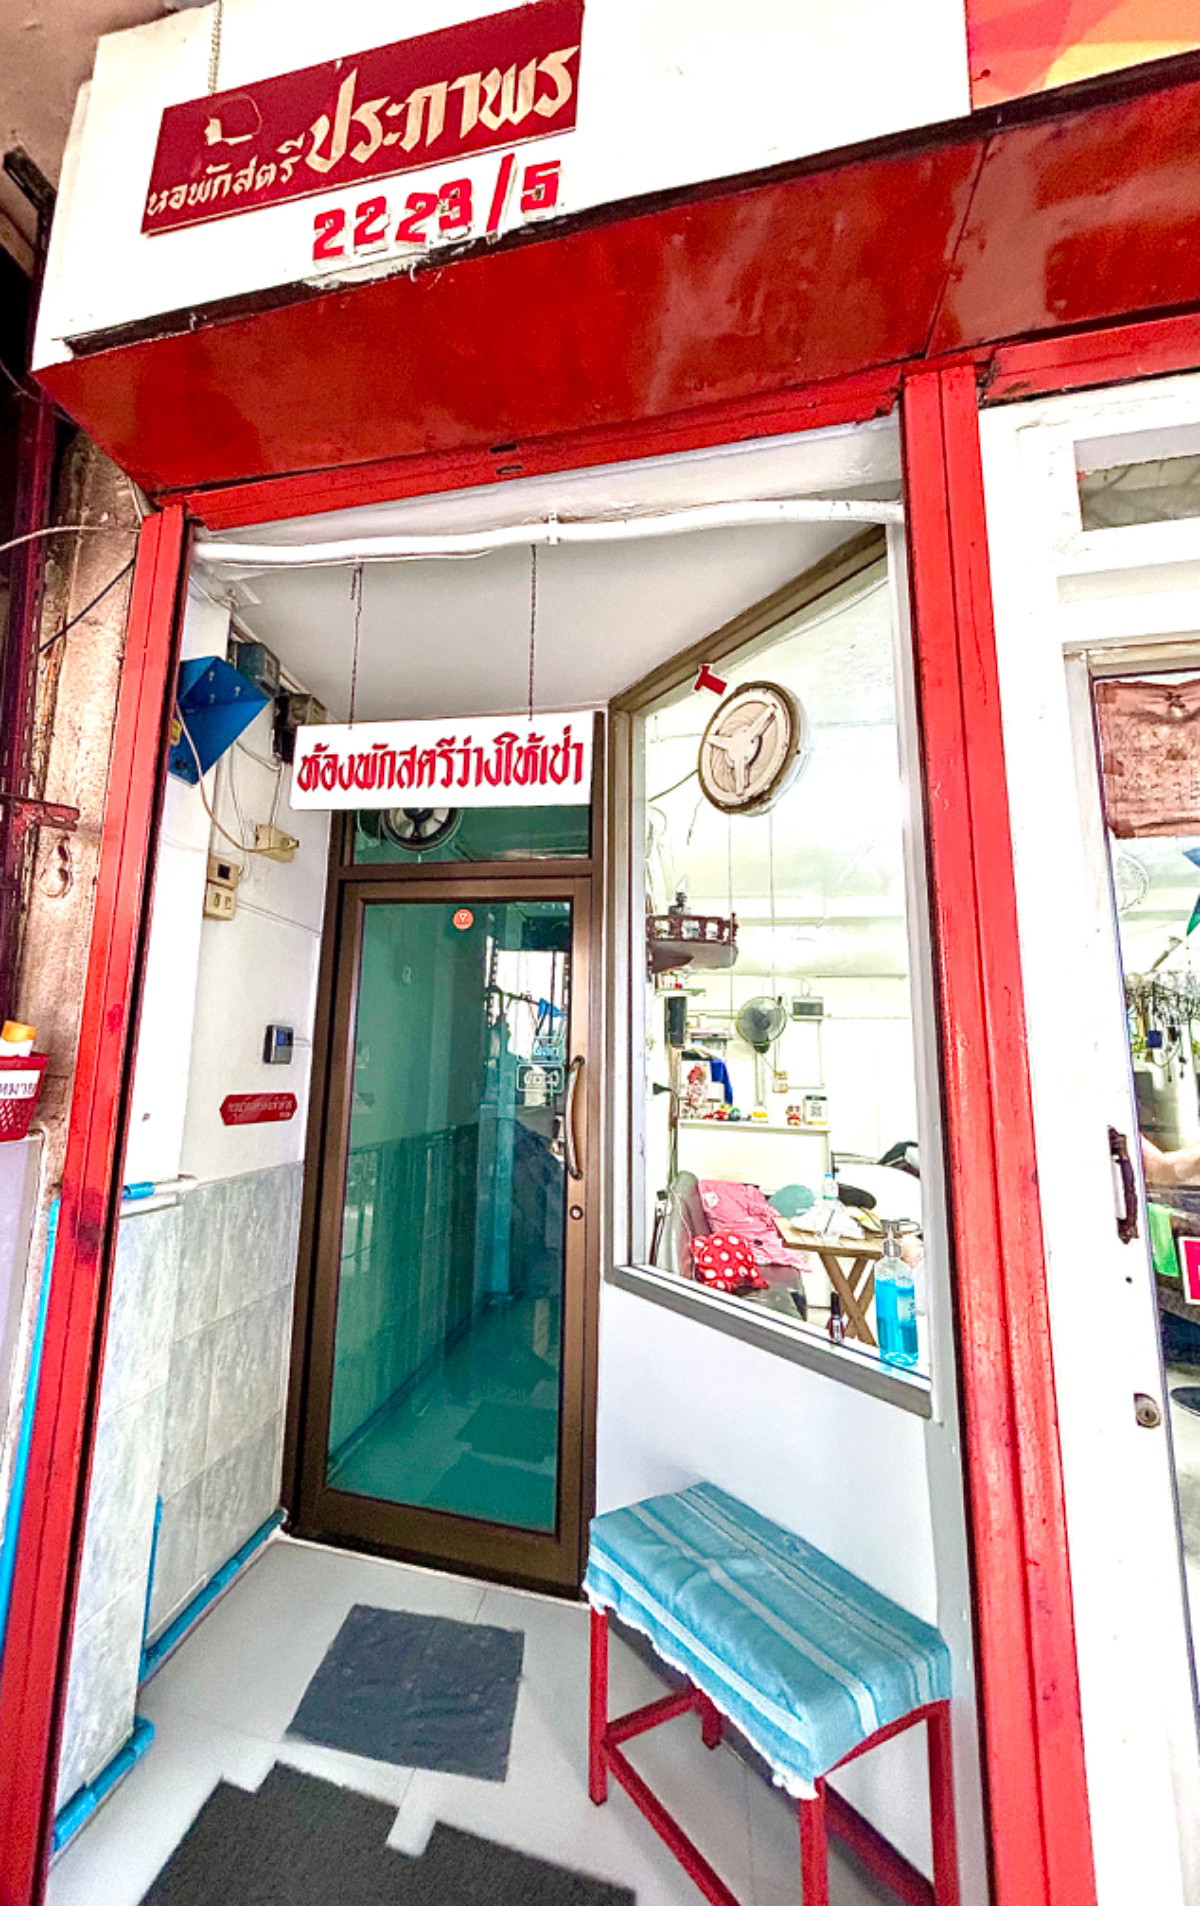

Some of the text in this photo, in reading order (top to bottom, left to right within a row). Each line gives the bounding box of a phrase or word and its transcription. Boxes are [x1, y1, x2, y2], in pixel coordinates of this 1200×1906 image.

[304, 45, 580, 174] ประภาพร
[146, 132, 305, 216] หอพักสตรี
[312, 153, 561, 261] 2223/5
[296, 725, 584, 792] ห้องพักสตรีว่างให้เช่า
